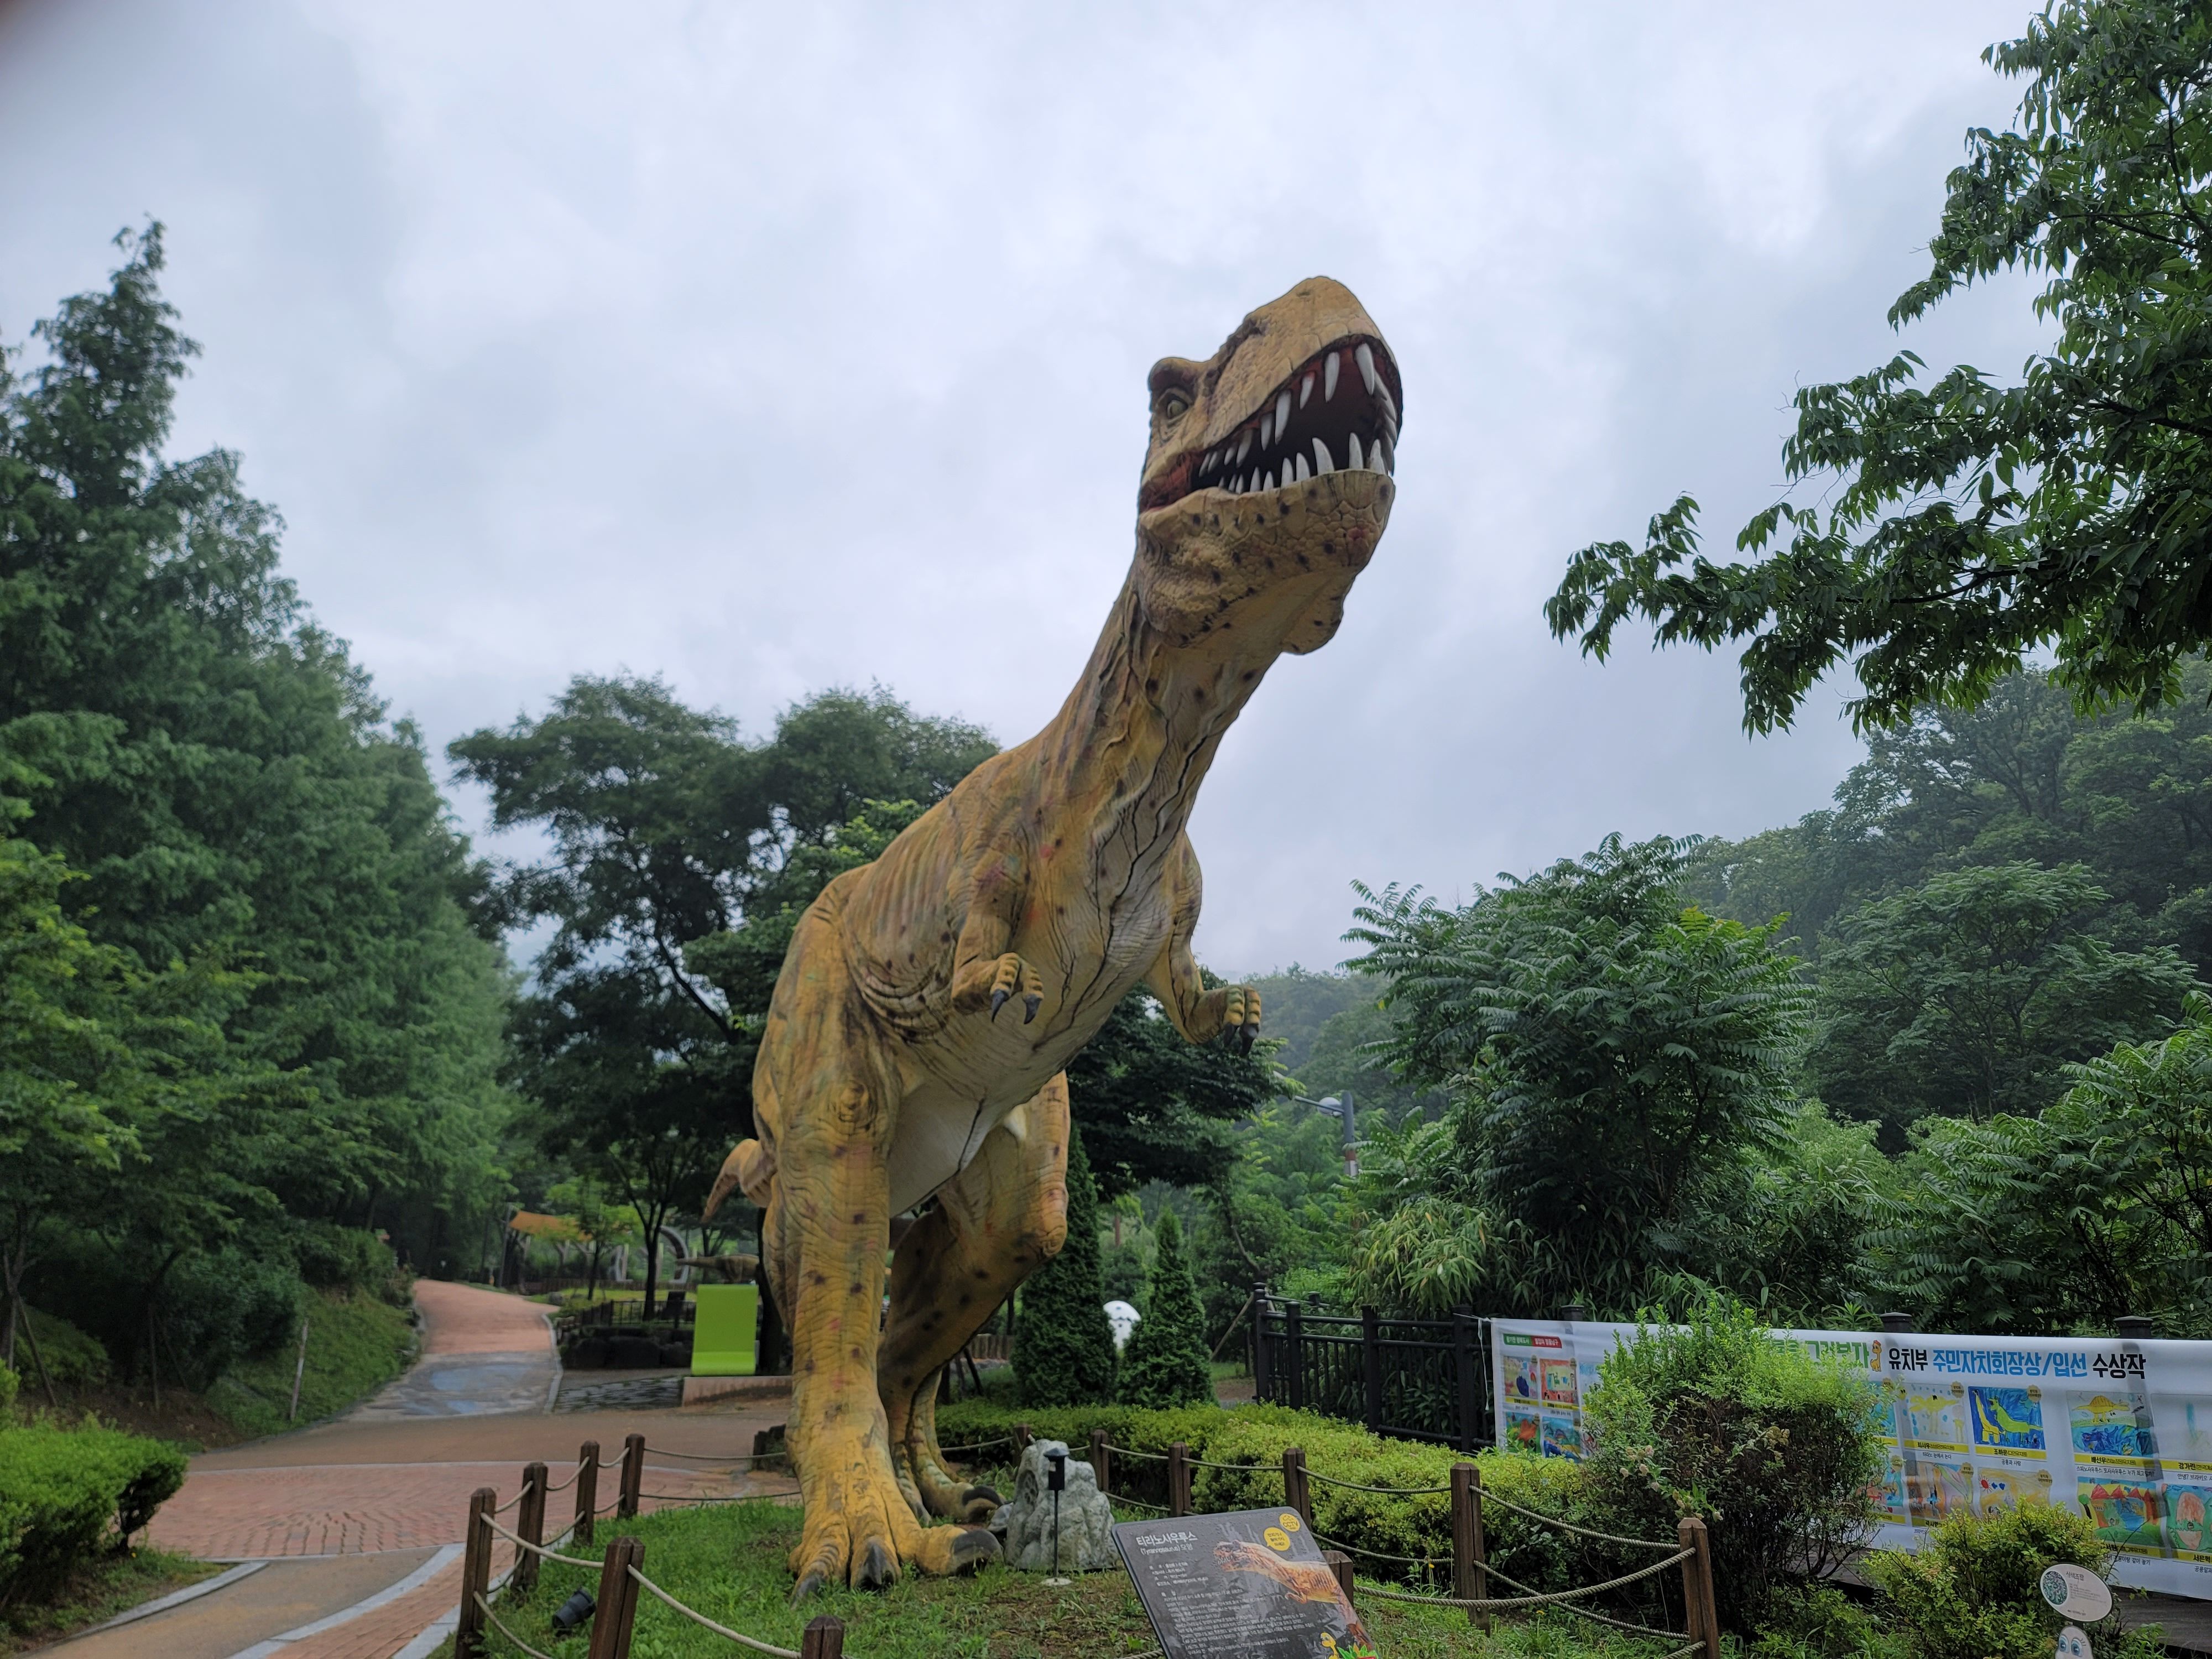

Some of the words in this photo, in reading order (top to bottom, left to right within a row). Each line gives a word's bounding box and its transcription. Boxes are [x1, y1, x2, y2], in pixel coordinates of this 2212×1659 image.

[1888, 1348, 1928, 1371] 유치부
[1933, 1349, 2088, 1377] 주민자치회장상/입선
[2093, 1353, 2146, 1379] 수상작
[1135, 1531, 1198, 1546] 티라노사우루스
